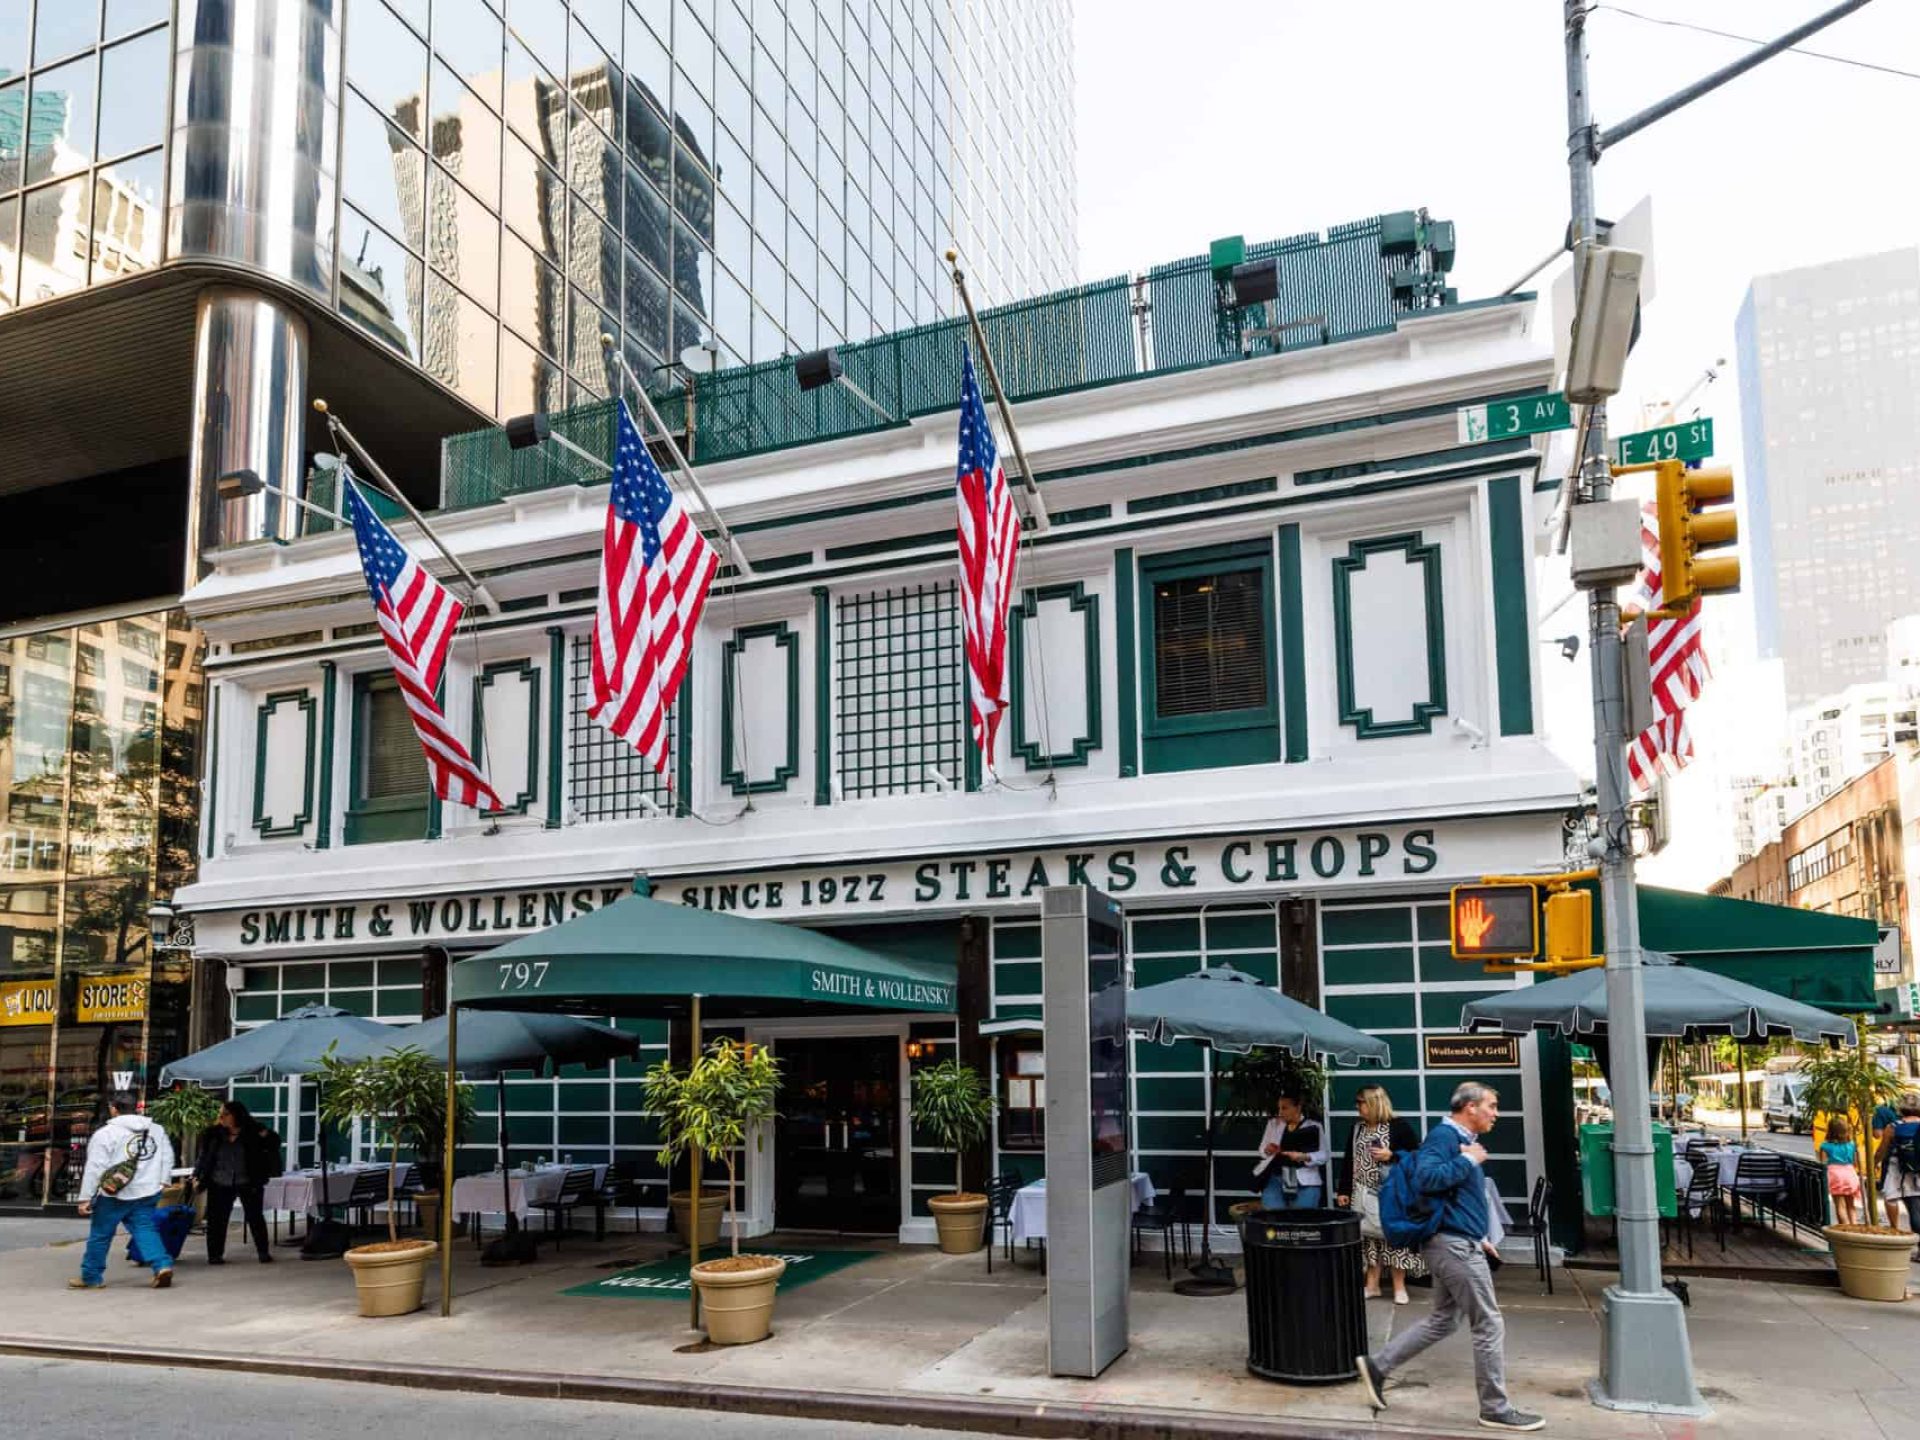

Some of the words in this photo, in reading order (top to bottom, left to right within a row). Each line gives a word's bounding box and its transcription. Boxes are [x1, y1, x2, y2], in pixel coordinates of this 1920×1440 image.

[1506, 405, 1520, 432] 3
[1646, 431, 1678, 461] 49
[1691, 423, 1707, 443] St
[914, 850, 1137, 902] STEAKS
[1161, 846, 1197, 888] &
[1221, 829, 1438, 883] CHOPS
[240, 906, 356, 944] SMITH
[368, 904, 393, 937] &
[681, 882, 784, 911] SINCE
[801, 874, 887, 906] 1977
[500, 962, 549, 990] 797
[812, 970, 860, 997] SMITH
[864, 978, 875, 998] &
[878, 980, 950, 1005] WOLLENSKY
[82, 984, 128, 1009] STORE
[1430, 1047, 1482, 1057] Wollensky's
[1485, 1046, 1508, 1054] Grill
